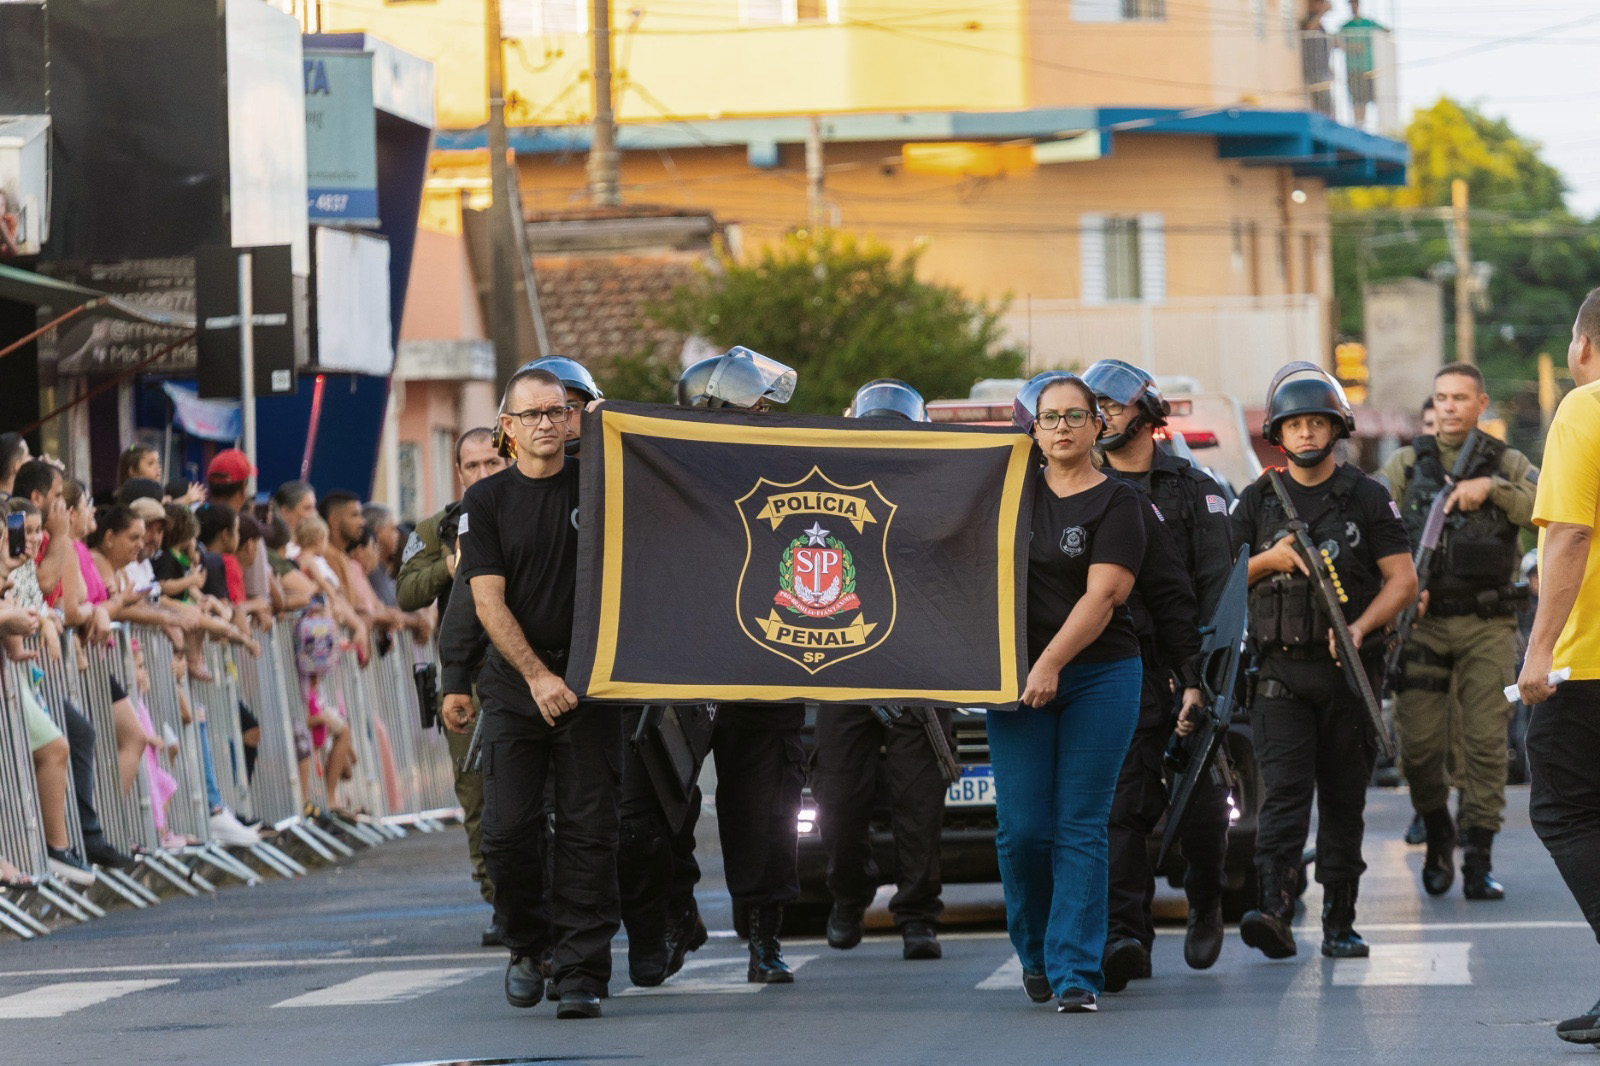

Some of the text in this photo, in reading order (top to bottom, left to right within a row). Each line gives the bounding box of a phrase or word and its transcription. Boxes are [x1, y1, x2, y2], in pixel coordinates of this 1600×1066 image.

[773, 493, 858, 517] POLÍCIA
[776, 627, 854, 646] PENAL
[803, 652, 825, 663] SP
[949, 780, 996, 800] GBP
